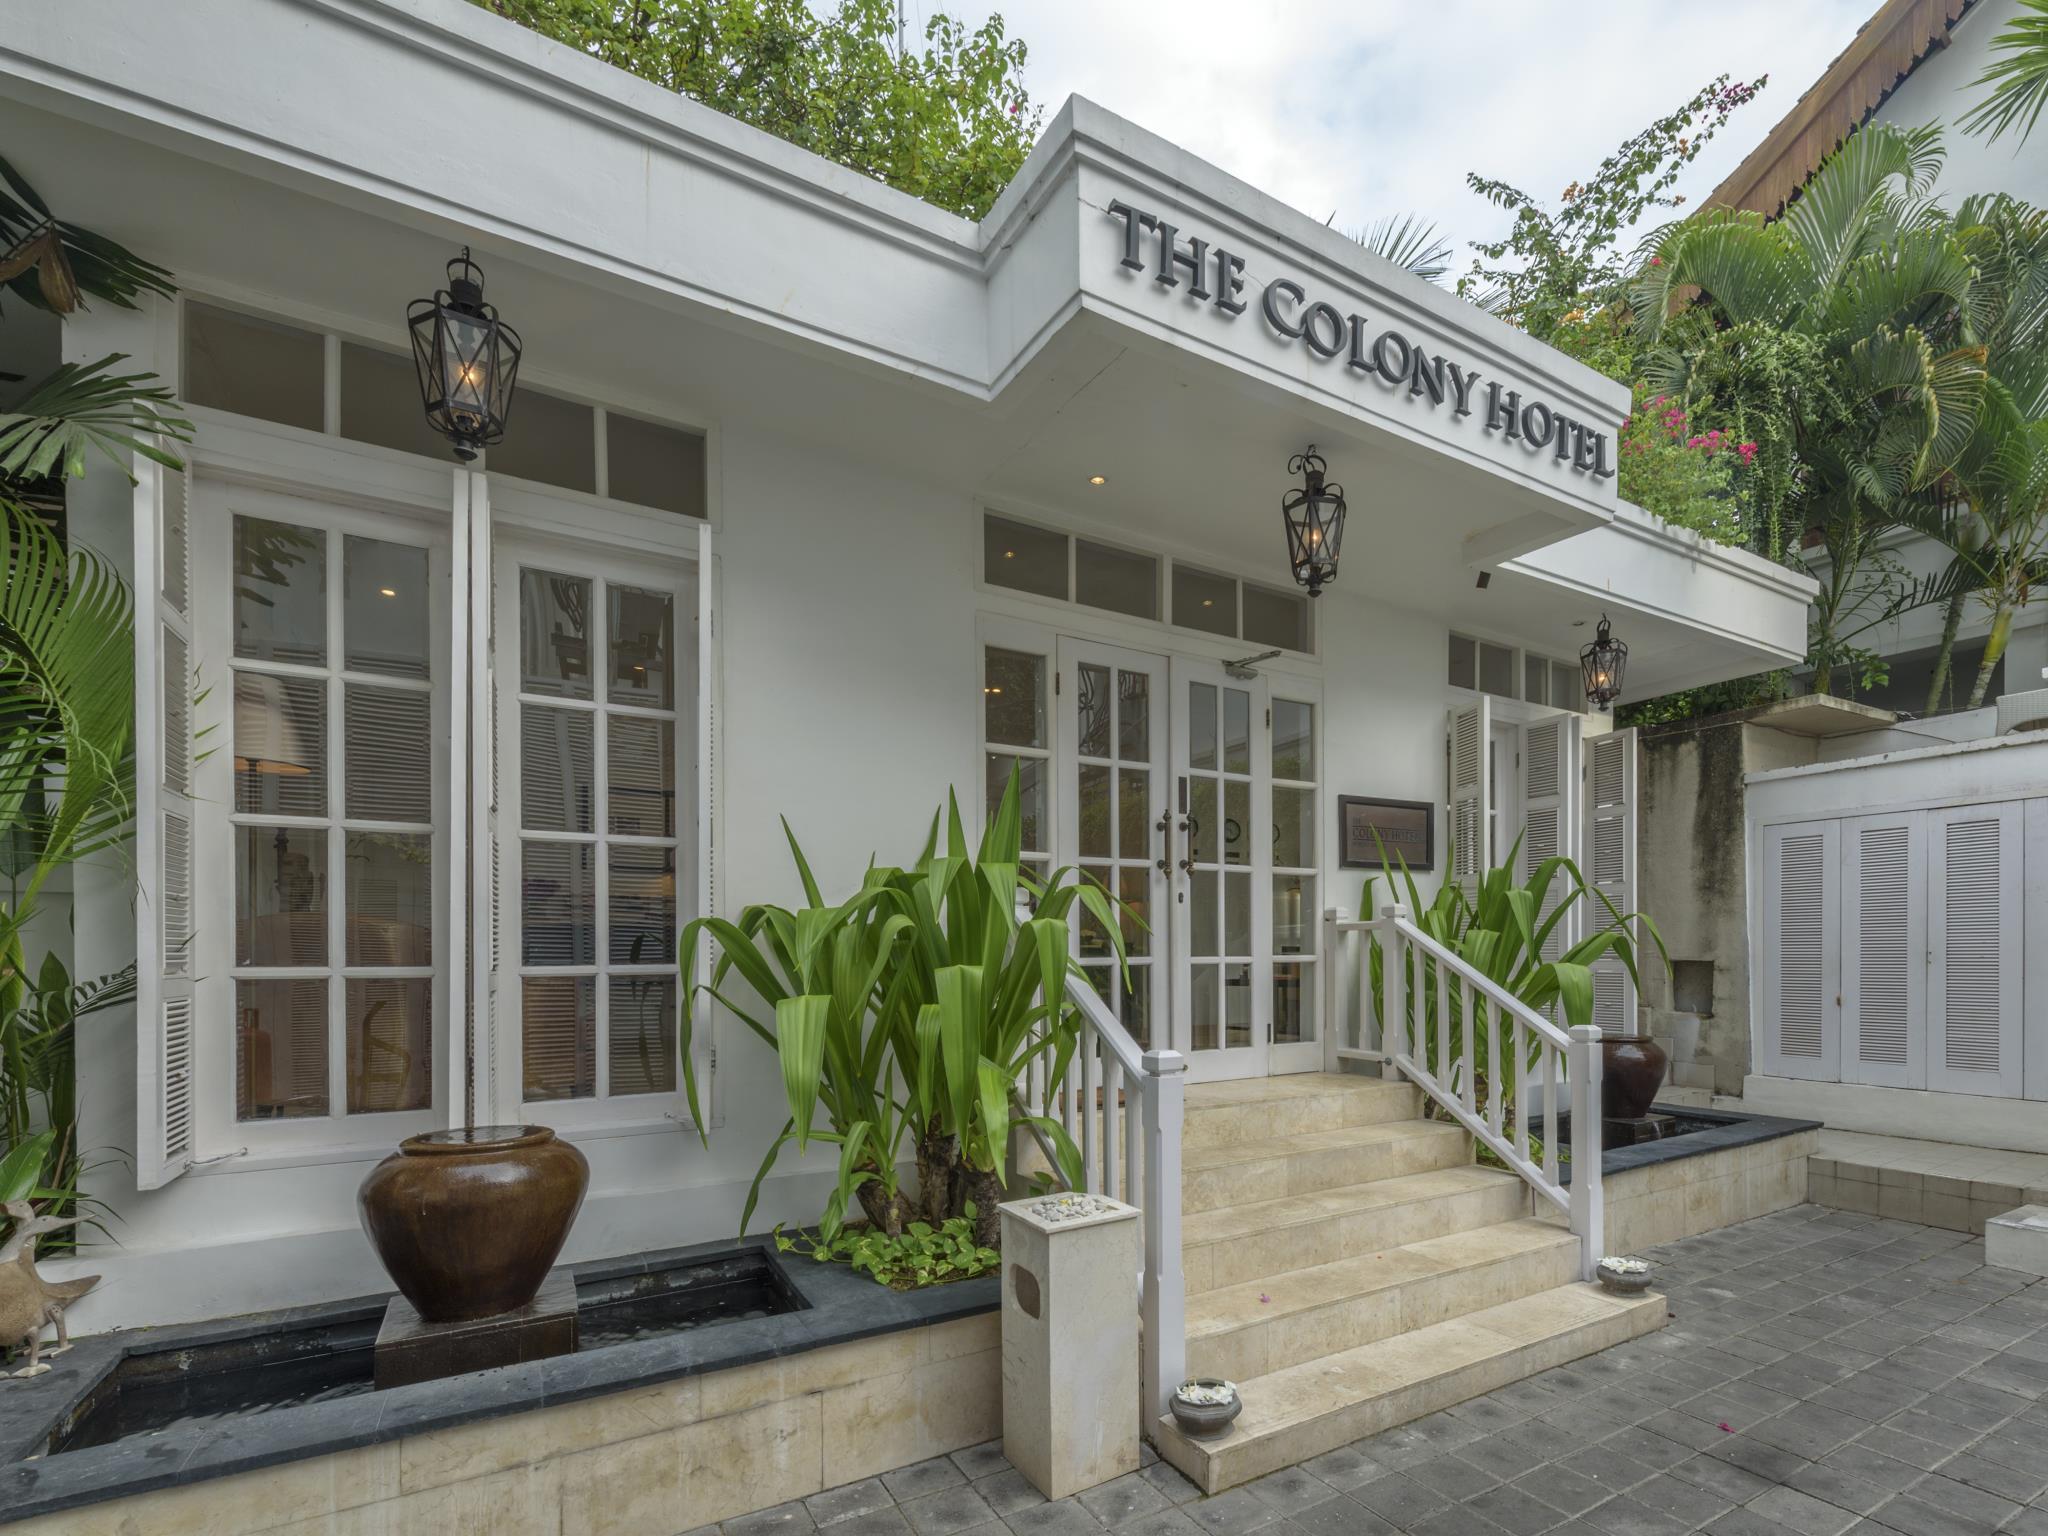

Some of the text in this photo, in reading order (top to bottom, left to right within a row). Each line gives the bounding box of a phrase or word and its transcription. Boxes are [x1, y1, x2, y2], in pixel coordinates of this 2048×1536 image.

[1108, 198, 1615, 478] THE COLONY HOTEL
